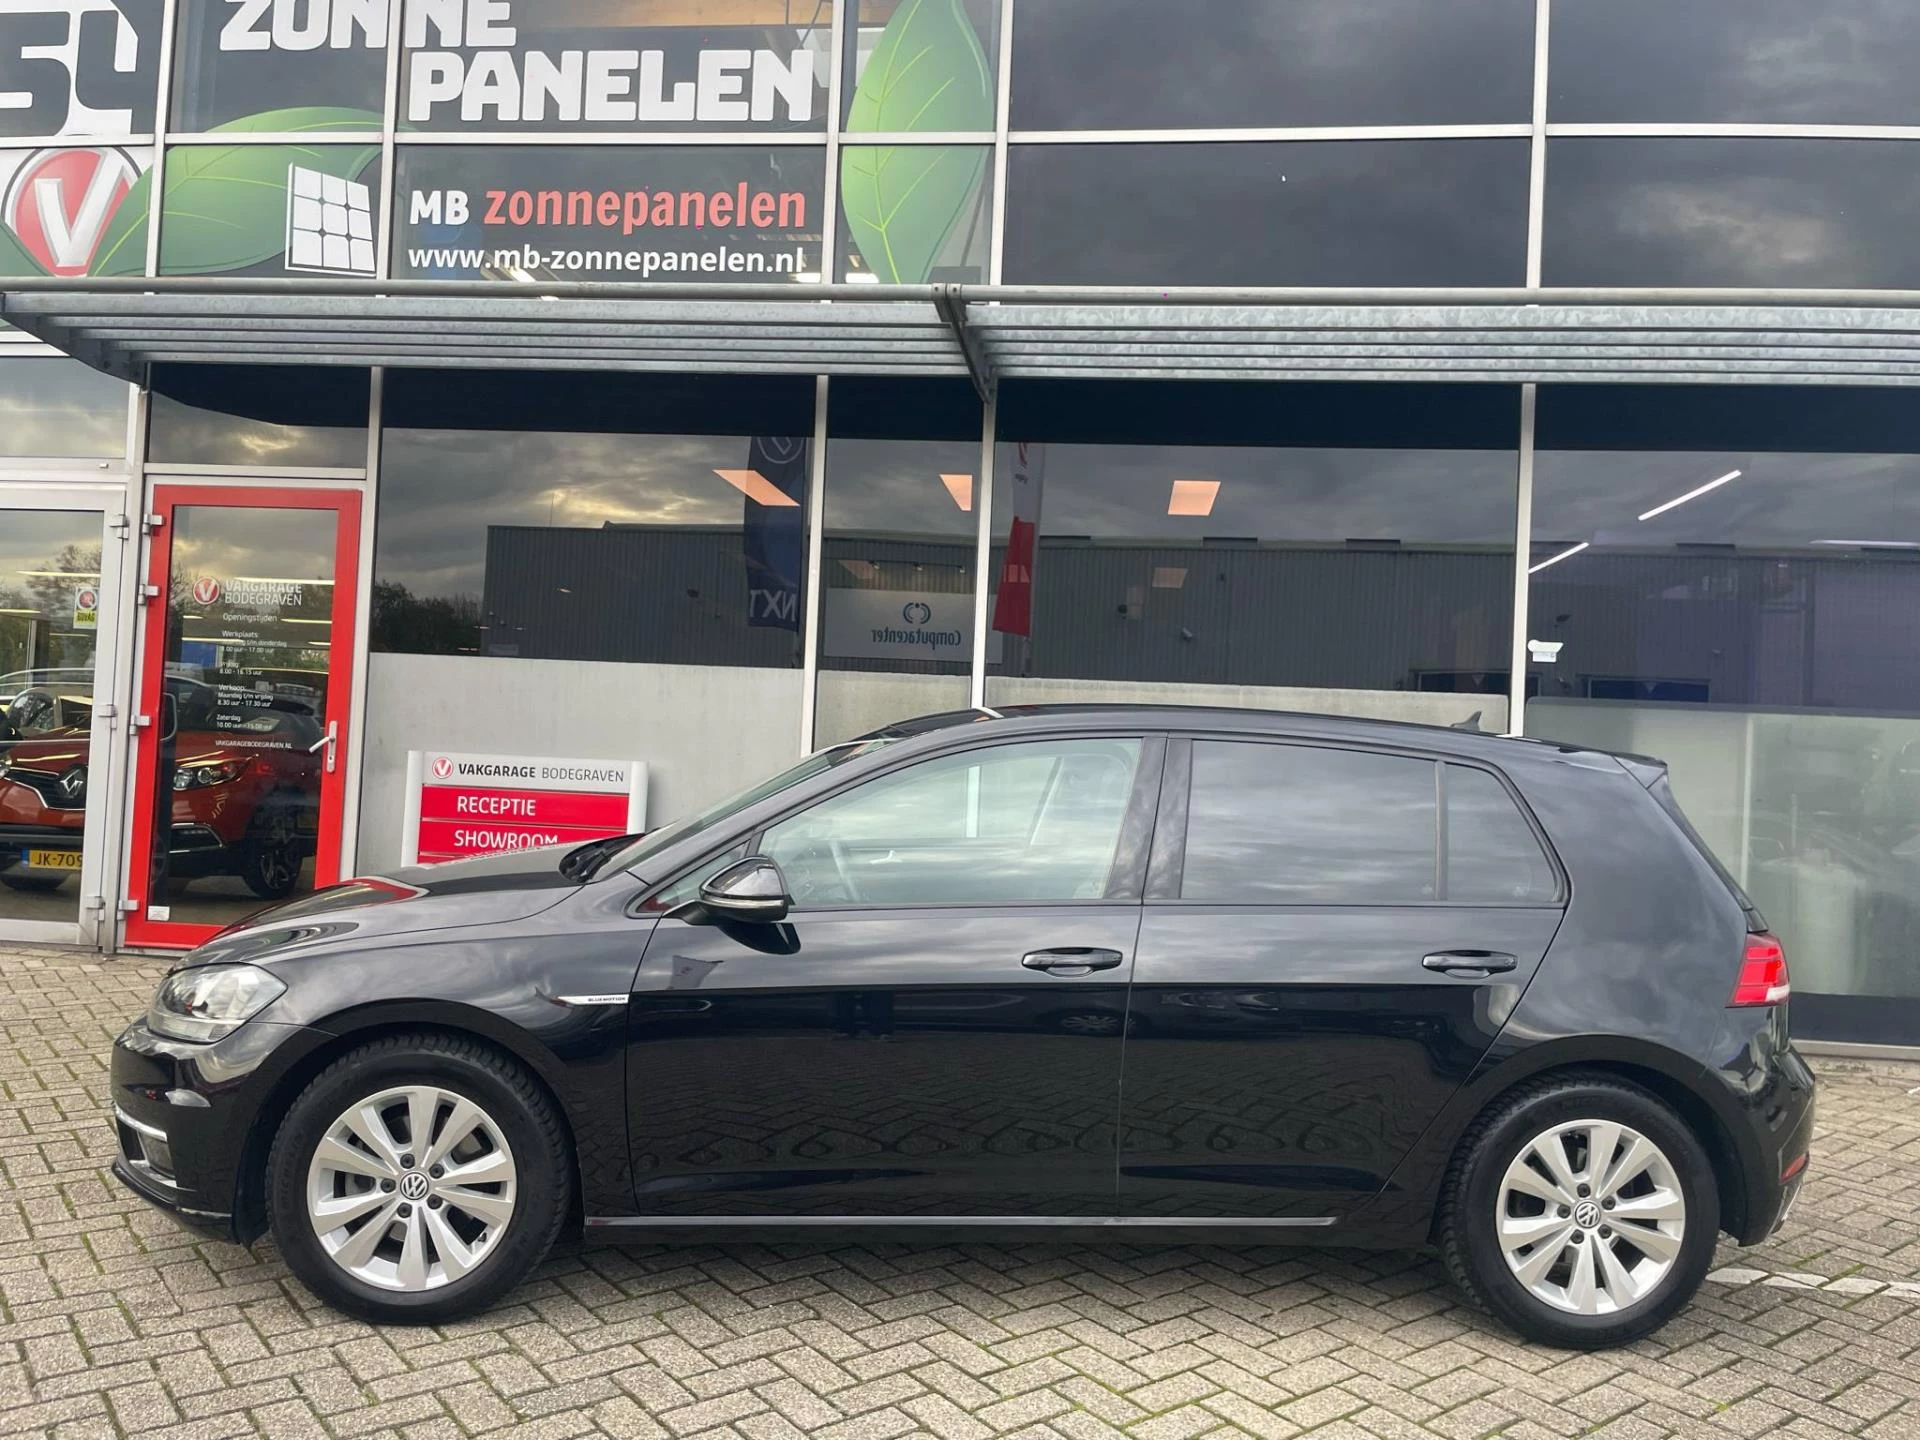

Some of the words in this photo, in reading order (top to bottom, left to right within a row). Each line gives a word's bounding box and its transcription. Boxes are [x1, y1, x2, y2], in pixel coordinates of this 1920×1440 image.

[220, 0, 517, 50] ZONNE
[408, 49, 814, 122] PANELEN
[409, 190, 470, 225] MB
[483, 181, 806, 235] zonnepanelen
[408, 244, 803, 278] www.mb-zonnepanelen.nl
[224, 579, 302, 594] VAKGARAGE
[224, 592, 302, 606] BODEGRAVEN
[222, 612, 278, 623] Openingstijden
[458, 763, 536, 778] VAKGARAGE
[542, 767, 624, 782] BODEGRAVEN
[456, 796, 536, 816] RECEPTIE
